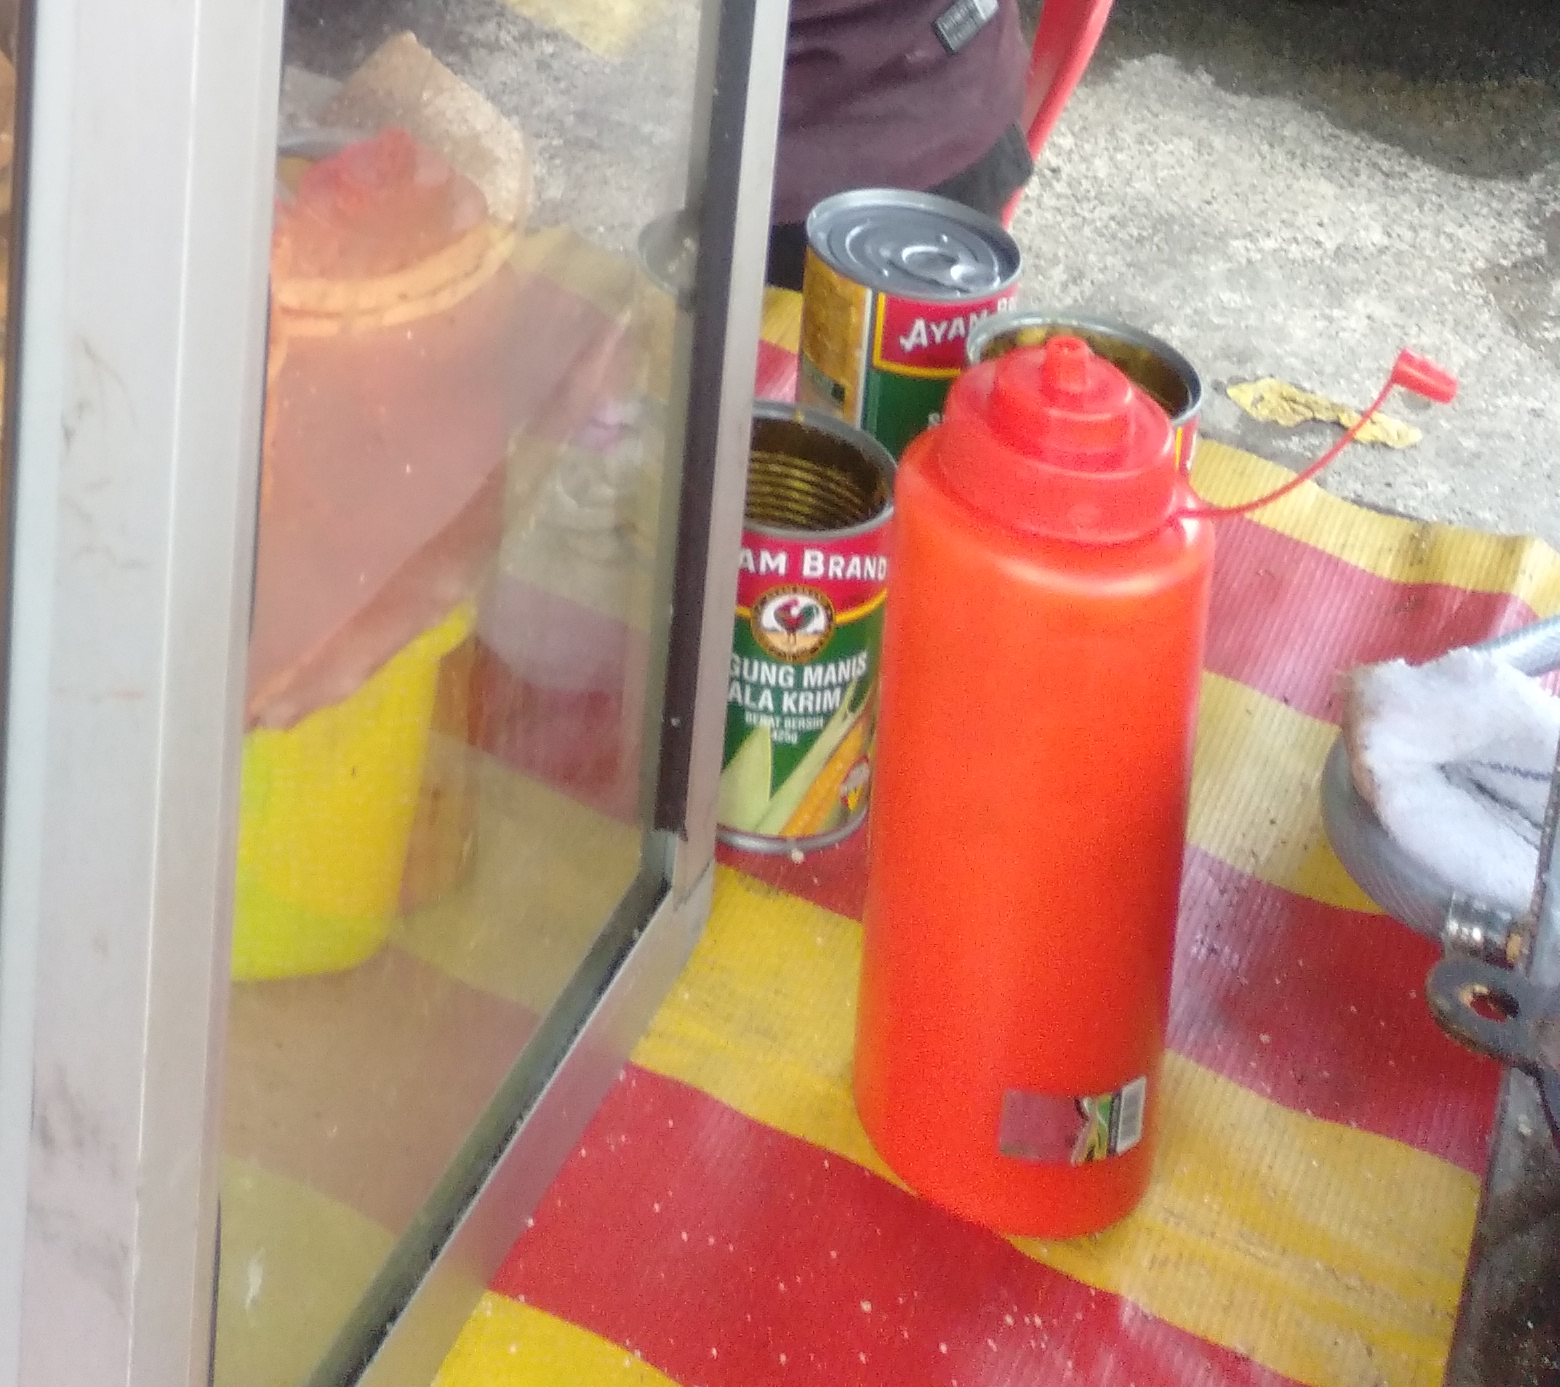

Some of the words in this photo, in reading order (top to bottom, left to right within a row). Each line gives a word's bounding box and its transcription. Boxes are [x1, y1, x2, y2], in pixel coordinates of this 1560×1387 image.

[802, 548, 888, 582] BRAND
[802, 650, 868, 689] MANIS
[782, 687, 842, 714] KRIM
